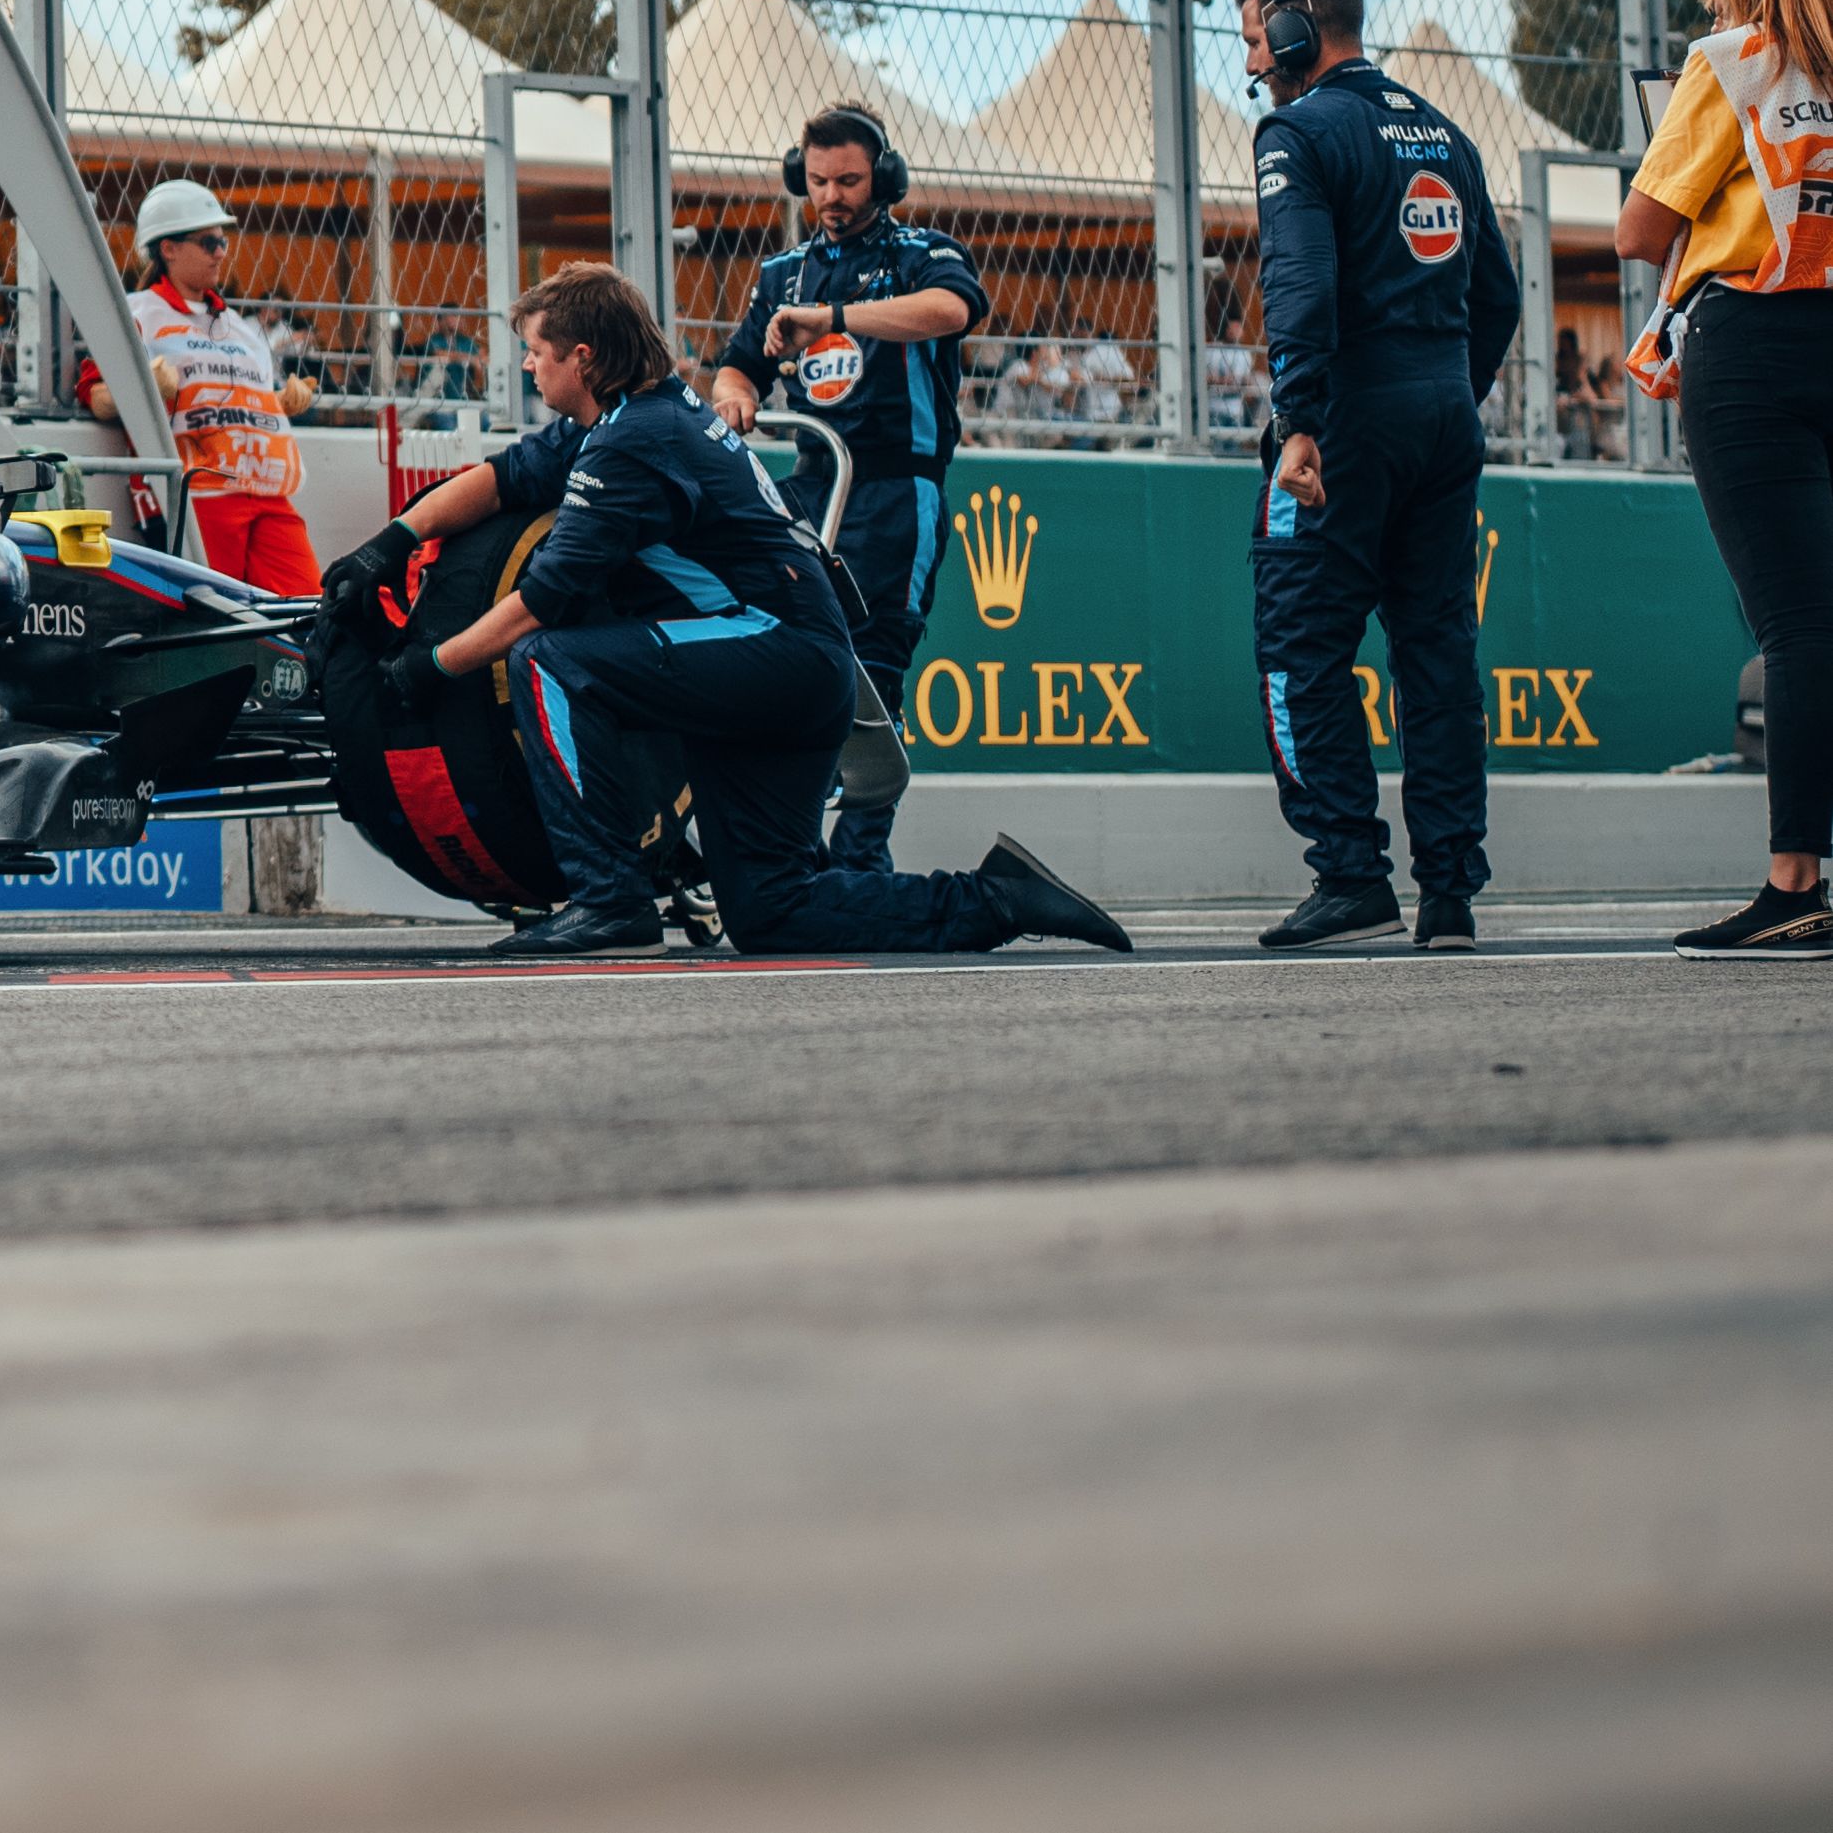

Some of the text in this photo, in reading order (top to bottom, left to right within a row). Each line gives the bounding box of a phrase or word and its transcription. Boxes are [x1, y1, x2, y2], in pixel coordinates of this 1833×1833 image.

[1395, 142, 1449, 161] RACNG
[1402, 202, 1459, 229] Gulf
[225, 429, 272, 456] PIT
[218, 452, 286, 482] LANE
[274, 668, 307, 693] FIA
[903, 658, 1150, 747] OLEX
[72, 796, 135, 828] purestream
[1787, 922, 1815, 938] DKNY
